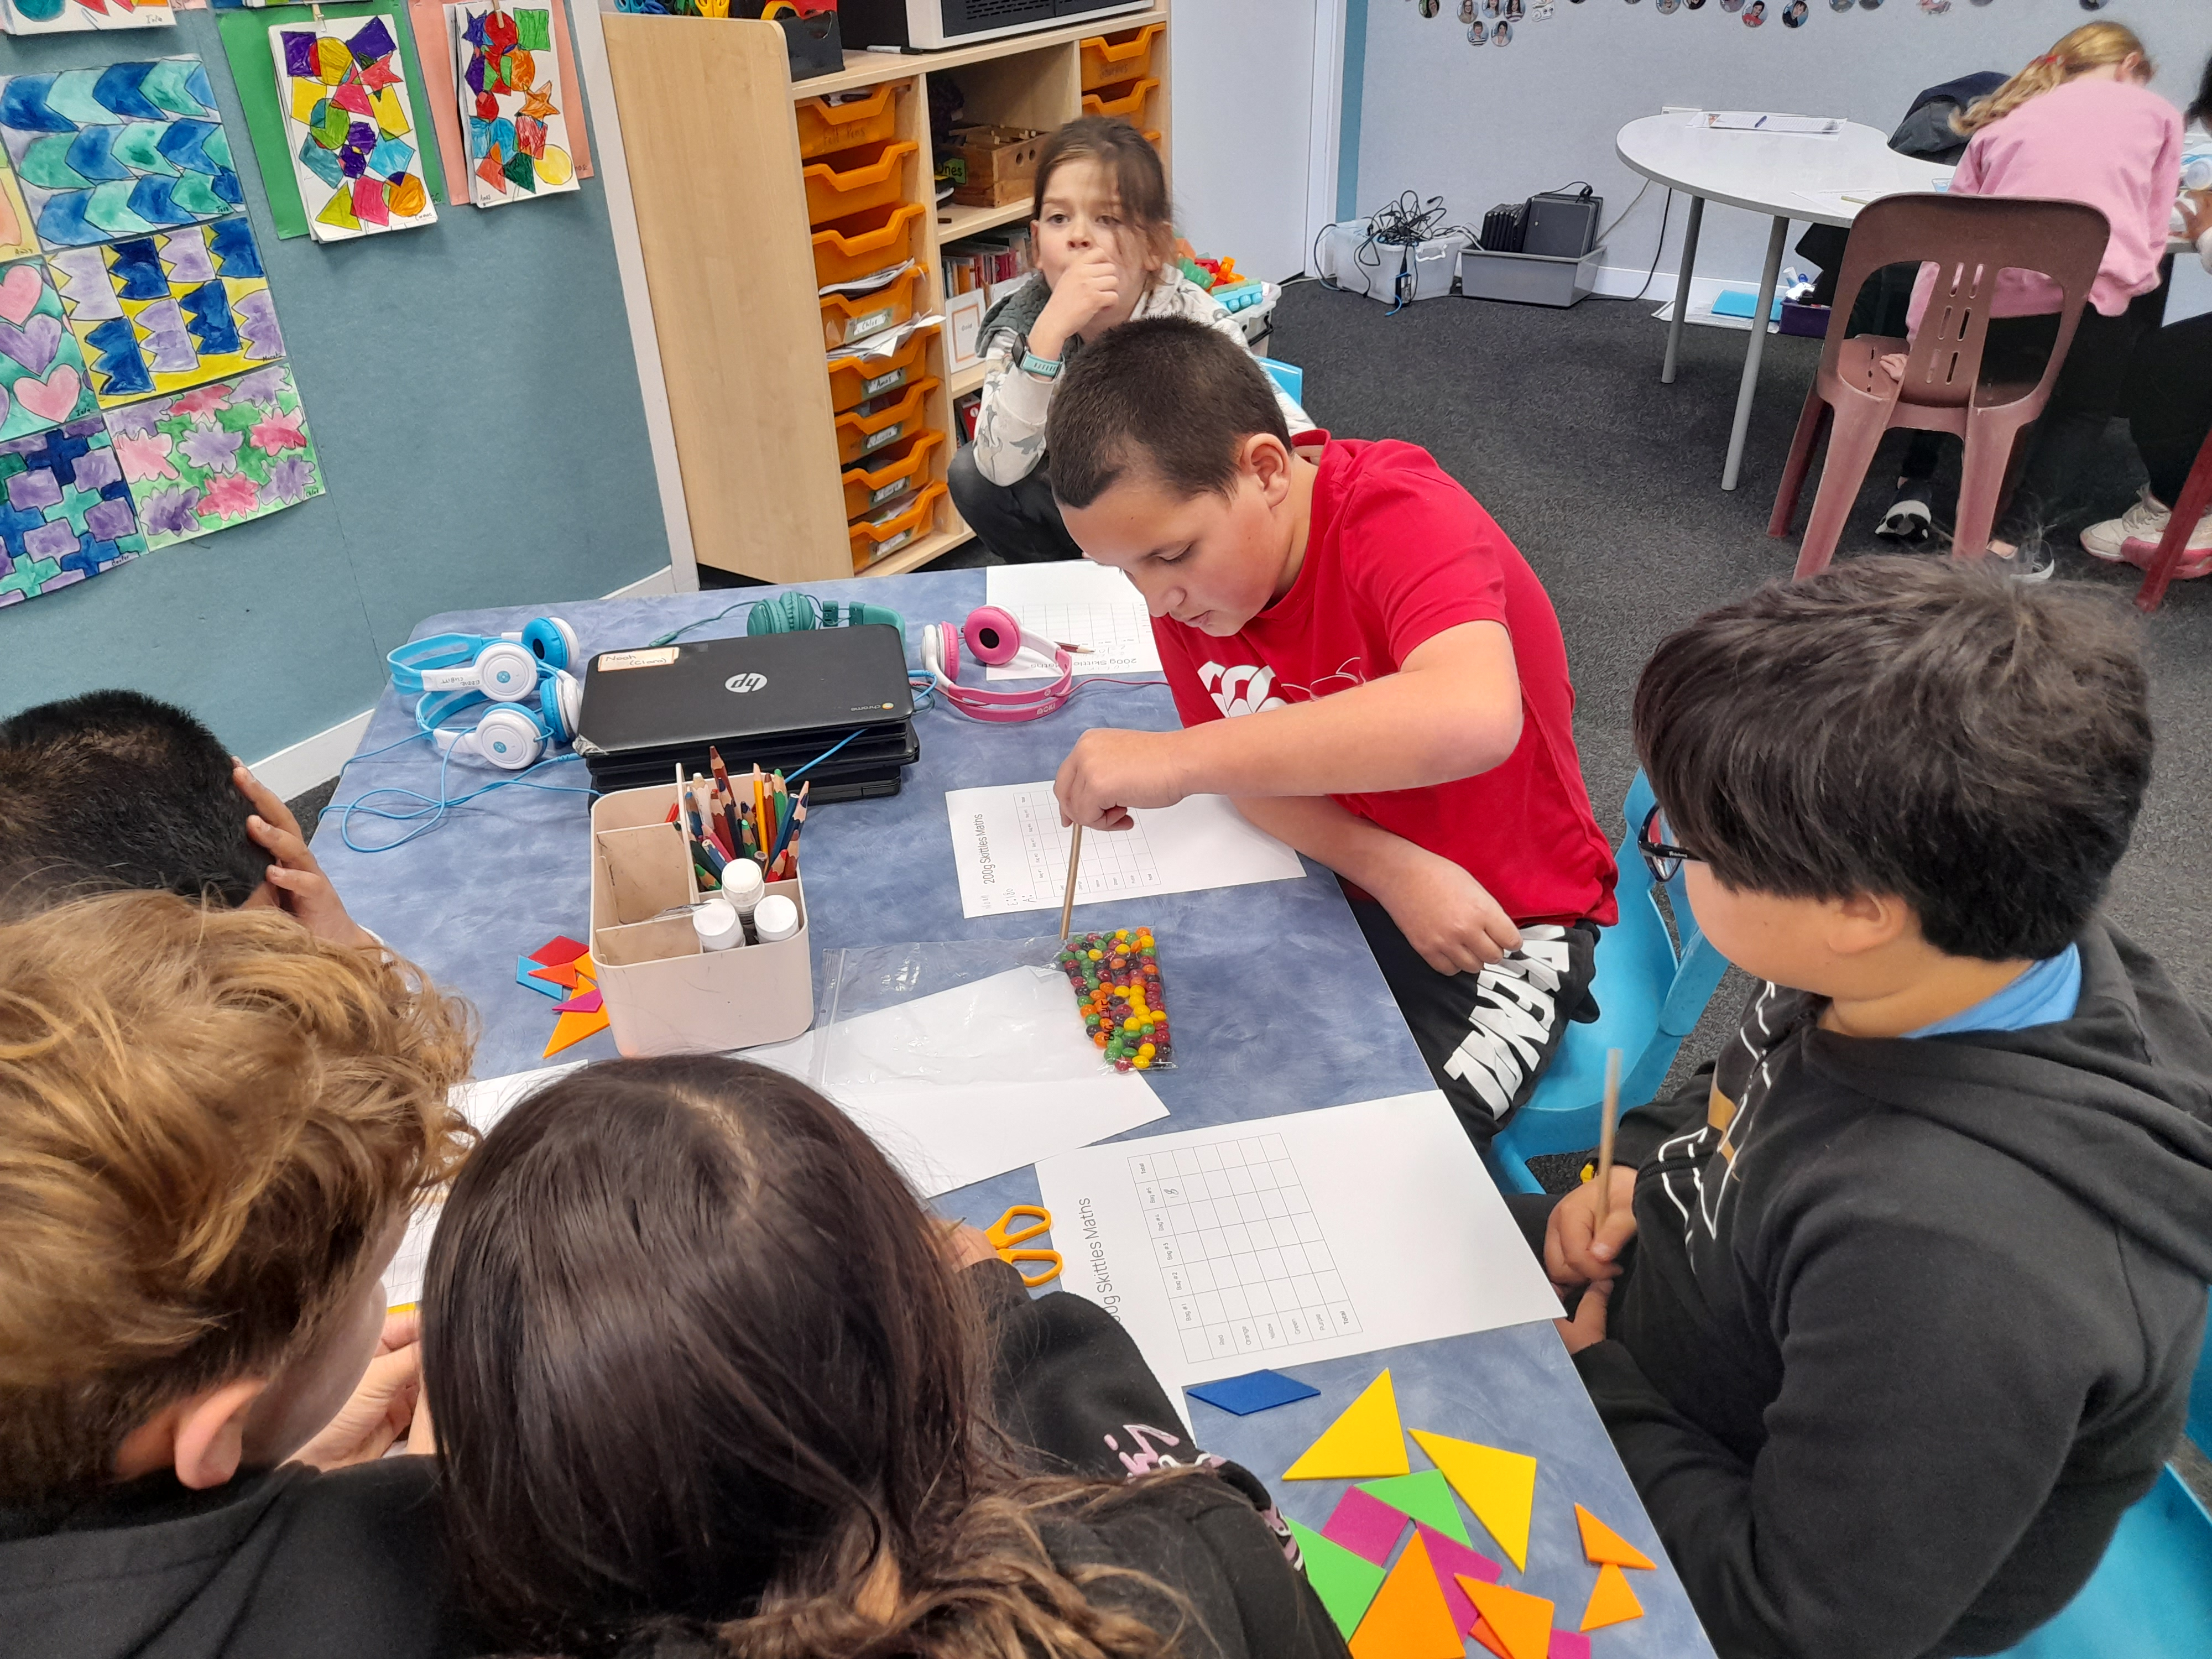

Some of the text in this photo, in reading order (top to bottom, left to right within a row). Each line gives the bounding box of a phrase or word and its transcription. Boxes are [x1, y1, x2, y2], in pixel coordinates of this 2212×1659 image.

[726, 673, 767, 693] hp
[973, 813, 996, 884] 200g Skittles Maths
[1079, 1198, 1099, 1240] Maths
[1090, 1241, 1113, 1293] Skittles
[1316, 1313, 1326, 1331] Purple
[1339, 1311, 1349, 1325] Total
[1242, 1326, 1251, 1345] Orange
